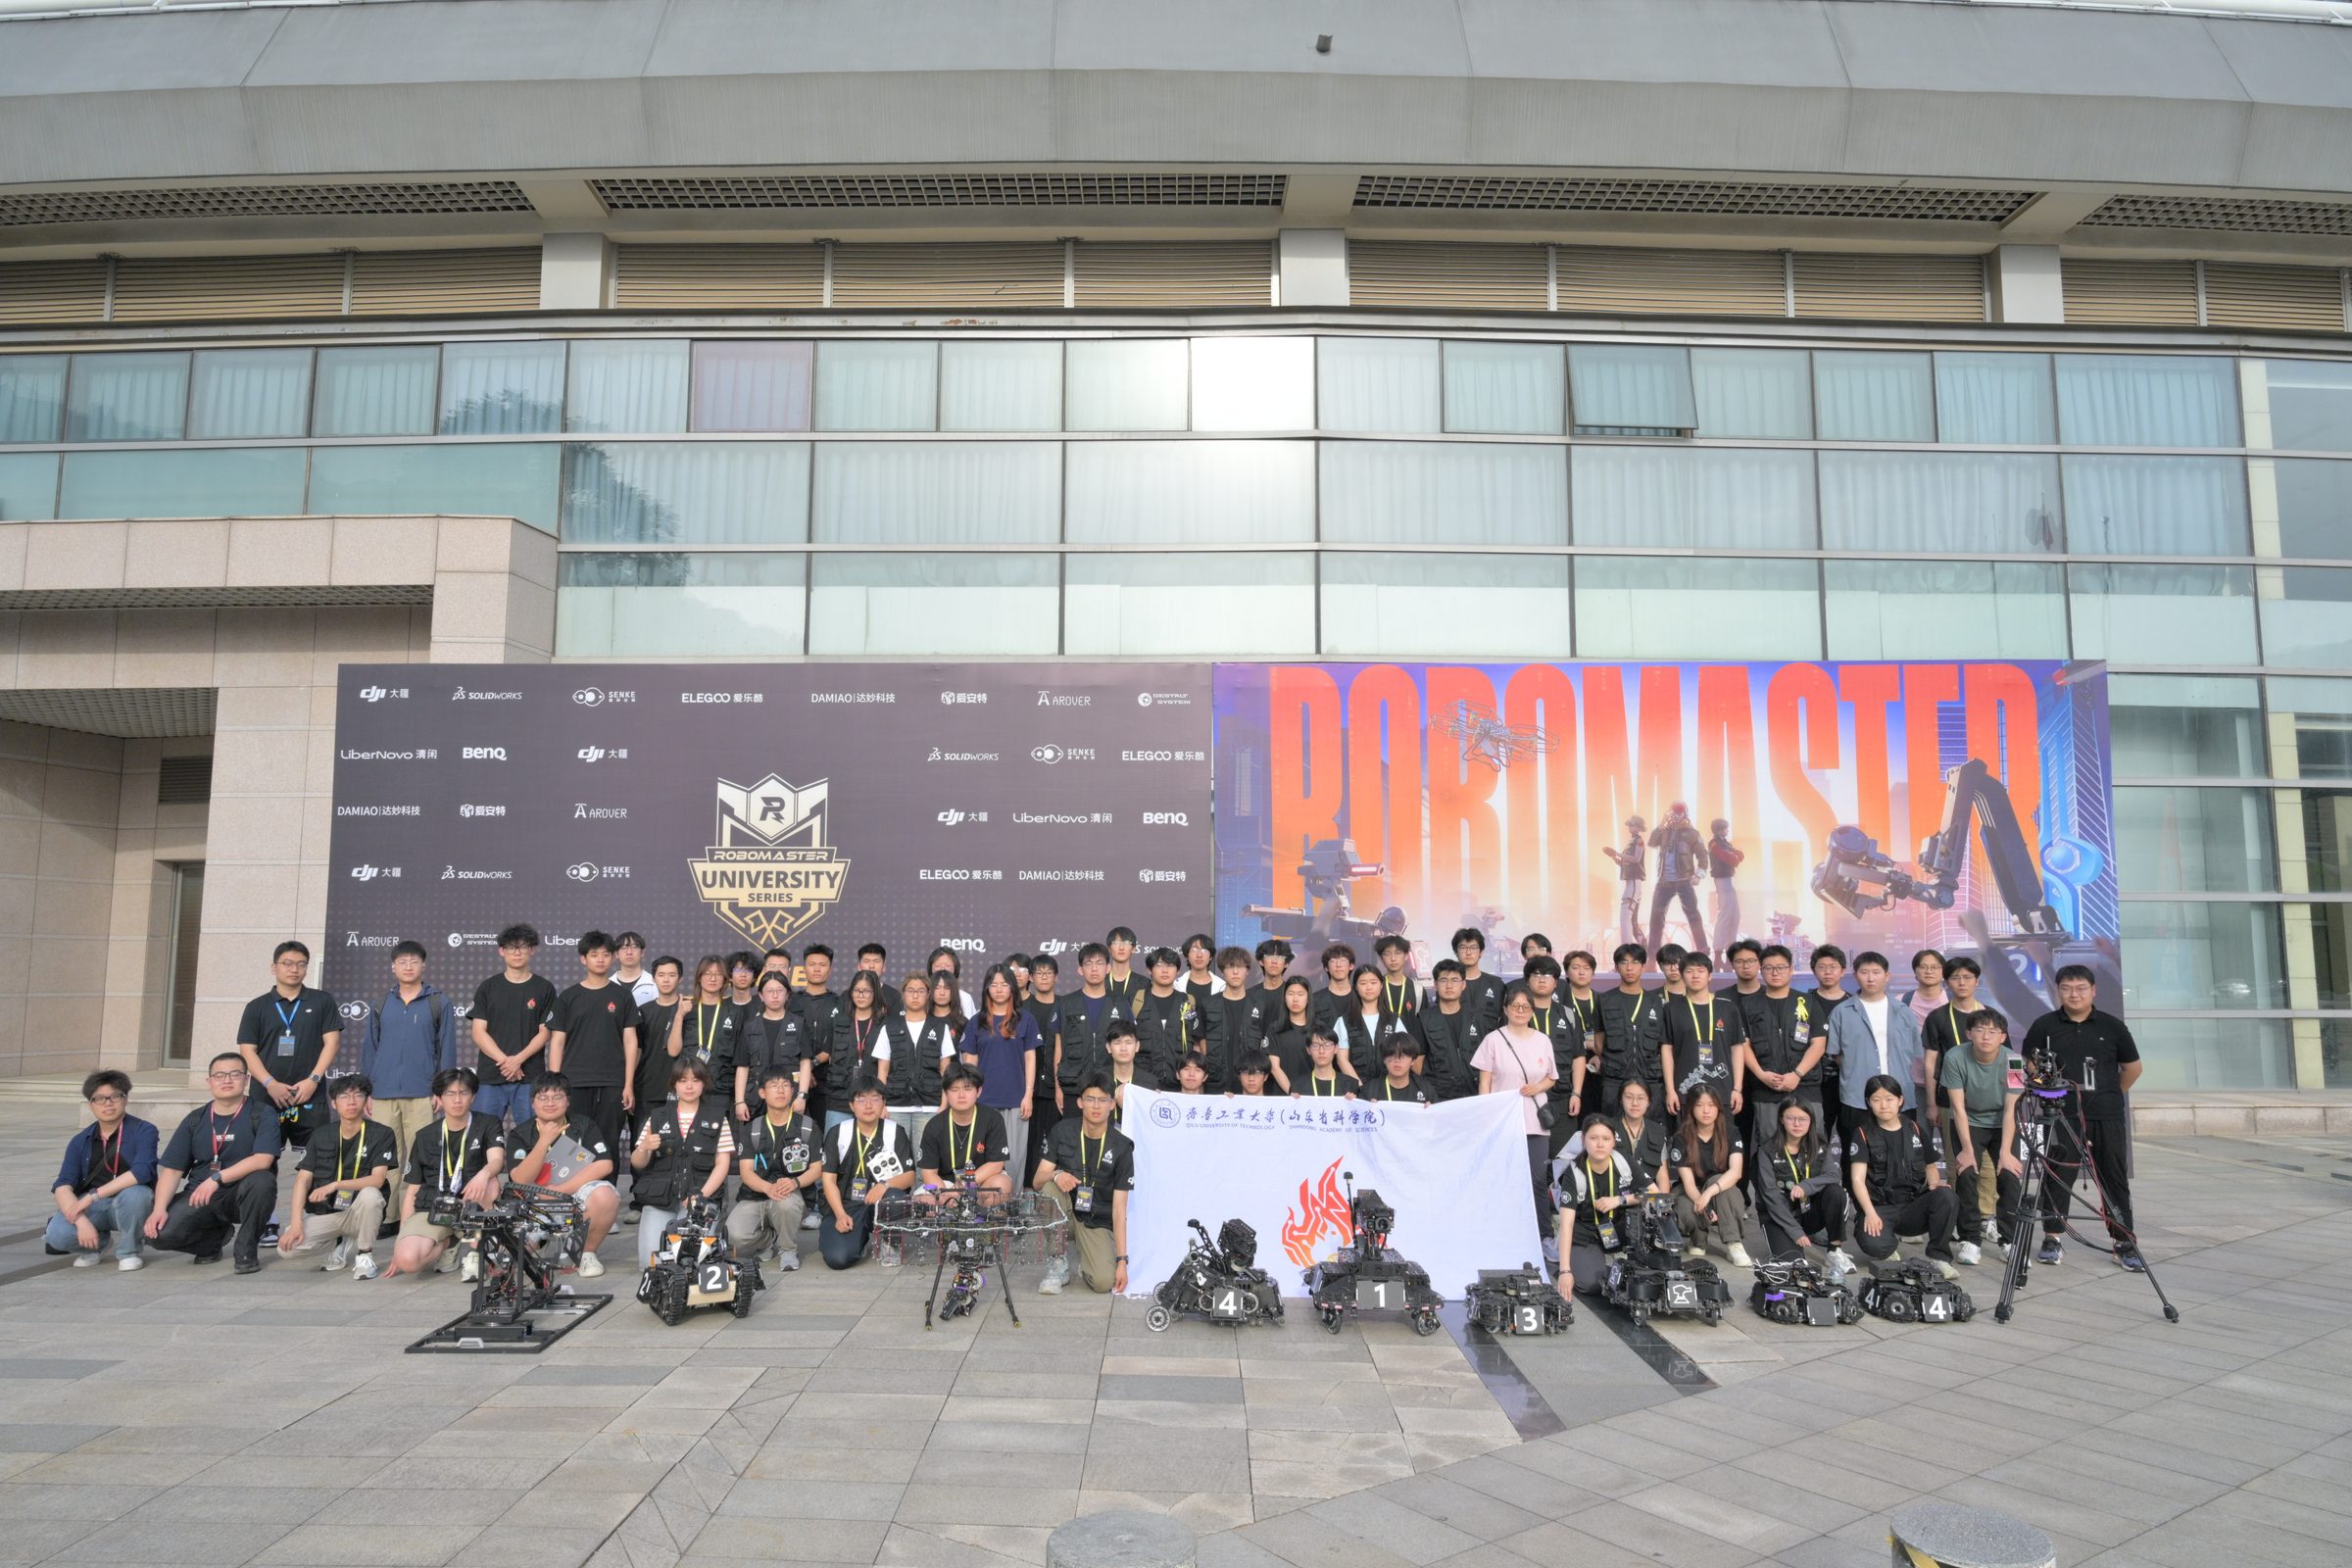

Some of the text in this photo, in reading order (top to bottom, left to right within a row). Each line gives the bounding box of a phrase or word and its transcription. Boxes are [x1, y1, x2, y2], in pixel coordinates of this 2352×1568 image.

[467, 691, 522, 701] SOLIDWORKS
[681, 692, 763, 704] ELEGOO 爱乐酷
[1052, 695, 1091, 707] AROVER
[462, 746, 508, 761] BenQ
[944, 753, 1000, 761] SOLIDWORKS
[1121, 751, 1205, 761] ELEGOO 爱乐酷
[588, 808, 627, 819] AROVER
[1143, 811, 1190, 827] BenQ
[713, 851, 829, 861] ROBOMASTER
[458, 870, 514, 880] SOLIDWORKS
[702, 870, 841, 889] UNIVERSITY
[919, 868, 1003, 881] ELEGOO 爱乐酷
[748, 893, 794, 903] SERIES
[361, 936, 400, 948] AROVER
[544, 934, 582, 946] Liber
[940, 938, 987, 954] BenQ
[707, 1265, 722, 1291] 2
[1374, 1283, 1386, 1308] 1
[1864, 1288, 1876, 1309] 4
[1218, 1291, 1238, 1315] 4
[1929, 1296, 1947, 1320] 4
[1522, 1307, 1538, 1332] 3
